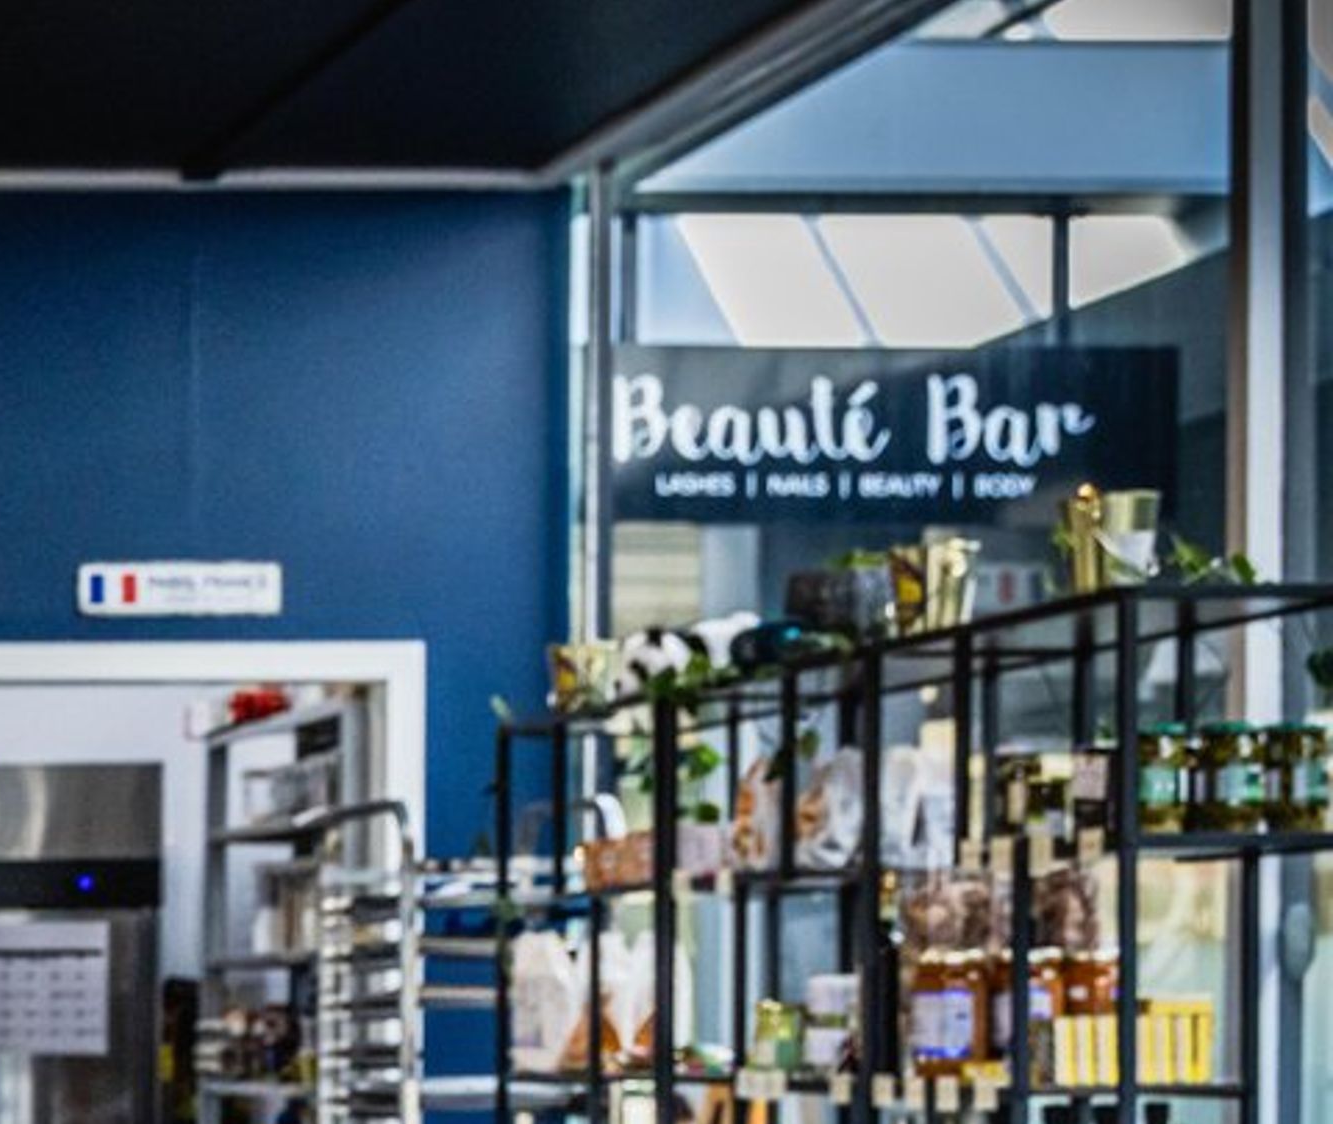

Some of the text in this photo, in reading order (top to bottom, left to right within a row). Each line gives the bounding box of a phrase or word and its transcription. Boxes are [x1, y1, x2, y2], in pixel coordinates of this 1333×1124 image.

[611, 373, 1096, 467] Beauté Bar
[766, 471, 831, 498] NAILS
[858, 471, 942, 498] BEAUTY
[974, 471, 1036, 498] BODY
